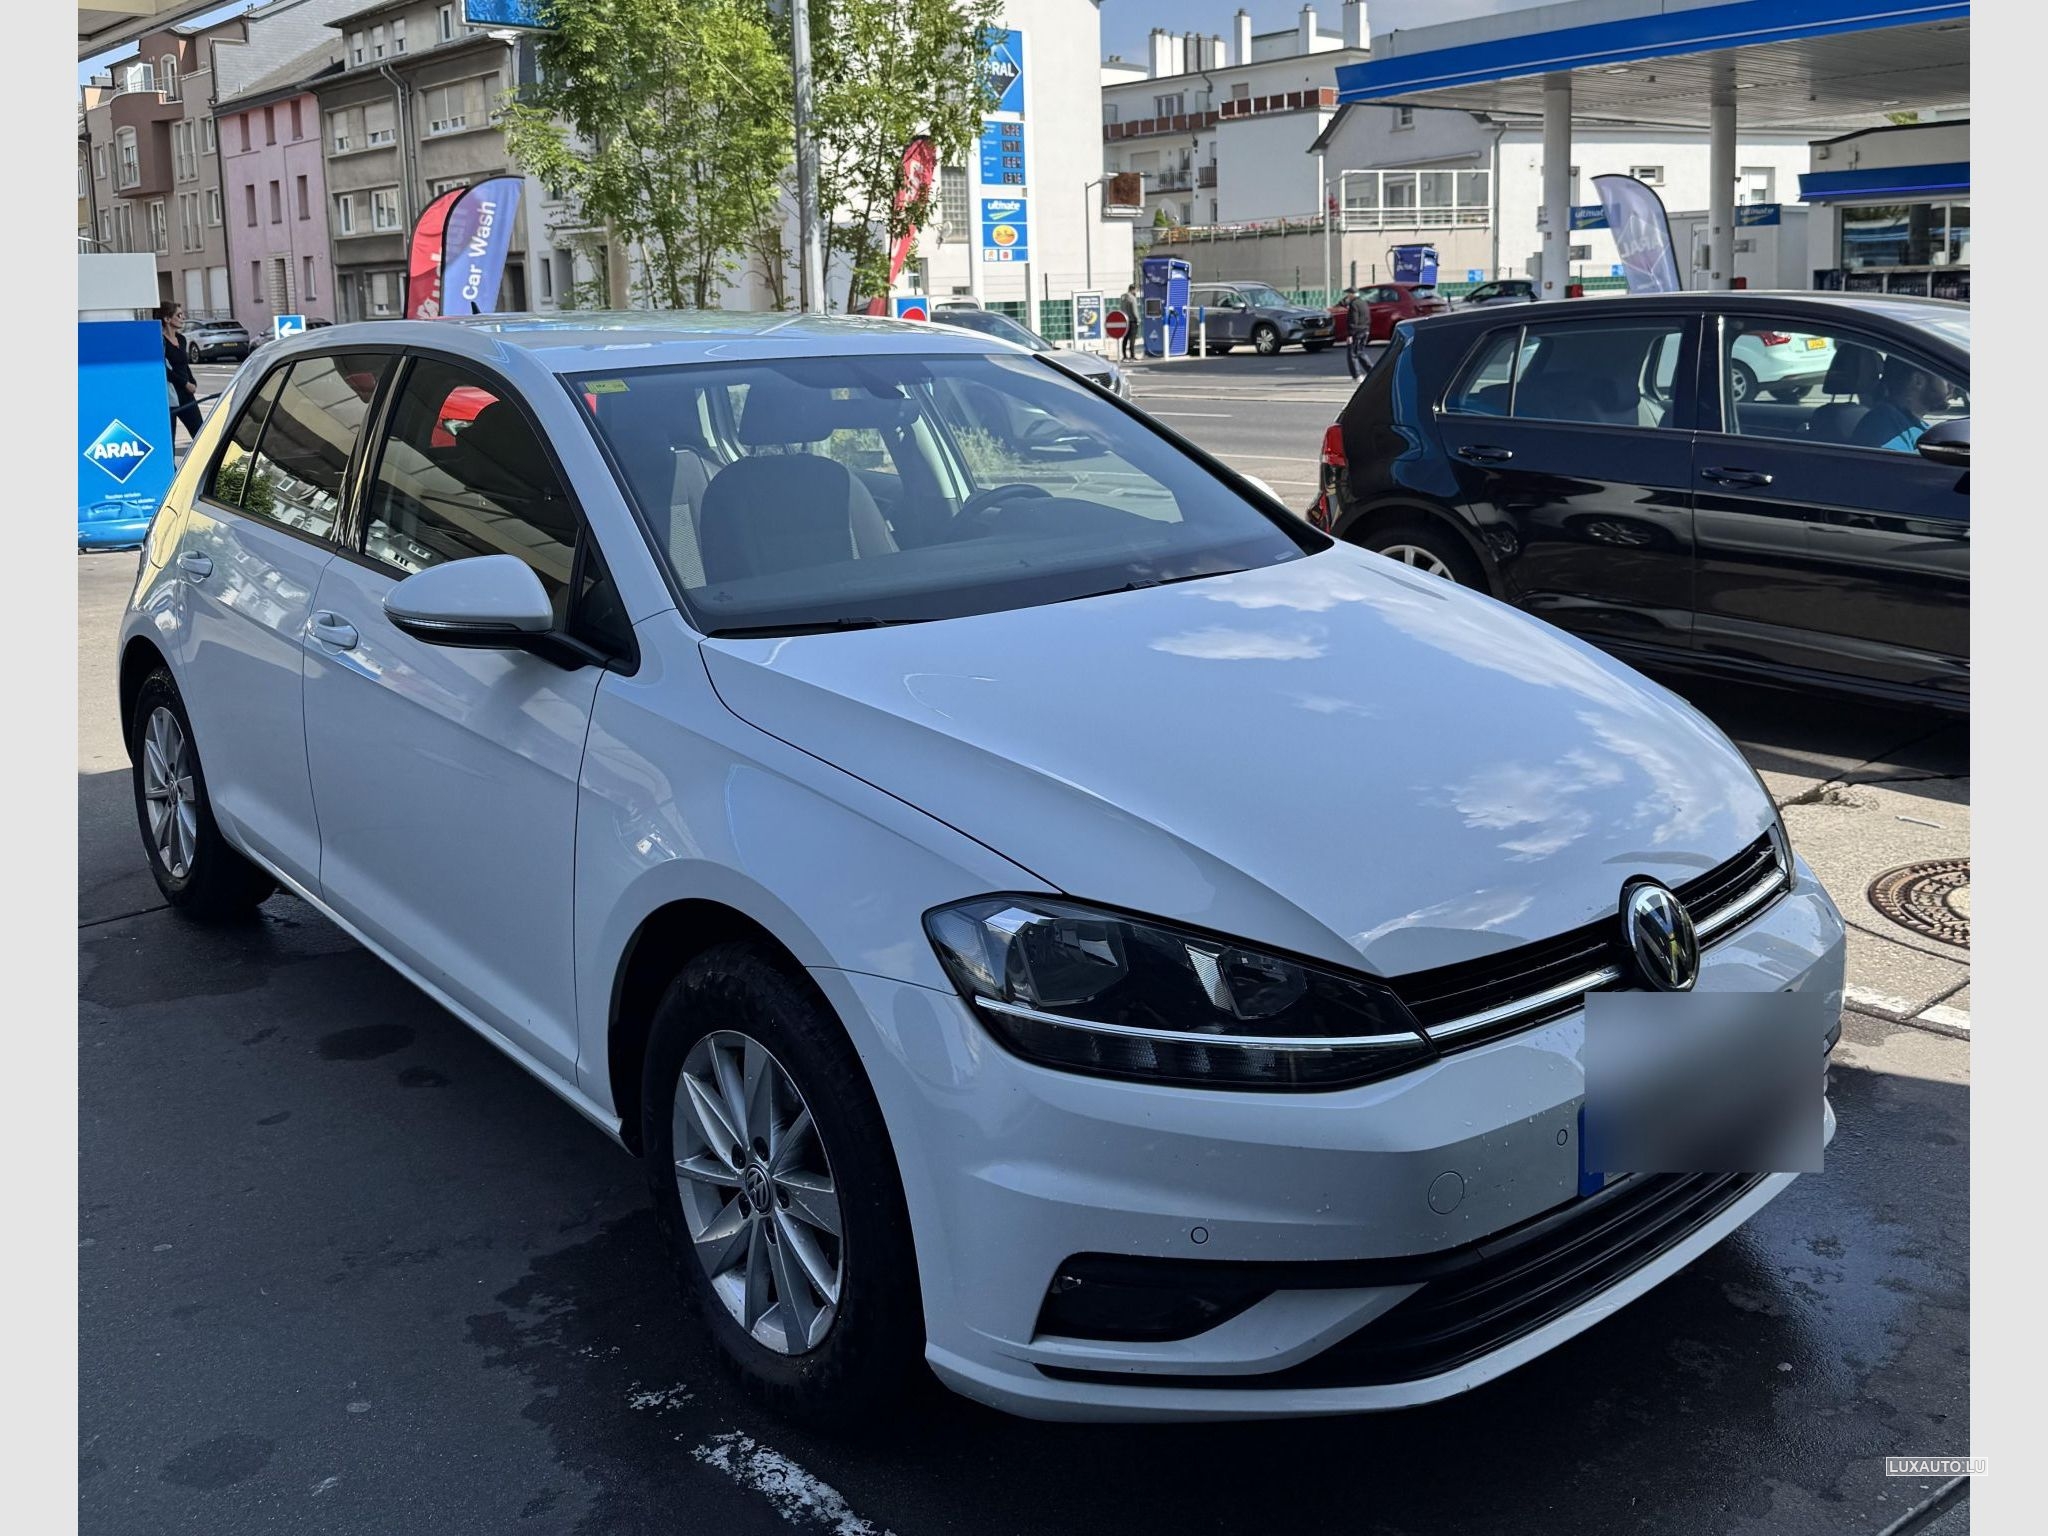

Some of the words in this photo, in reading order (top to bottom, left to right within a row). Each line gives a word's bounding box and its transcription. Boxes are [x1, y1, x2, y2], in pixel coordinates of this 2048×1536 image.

[1575, 208, 1604, 218] ultimat
[468, 201, 497, 258] Wash
[462, 264, 483, 300] Car
[94, 441, 145, 460] ARAL
